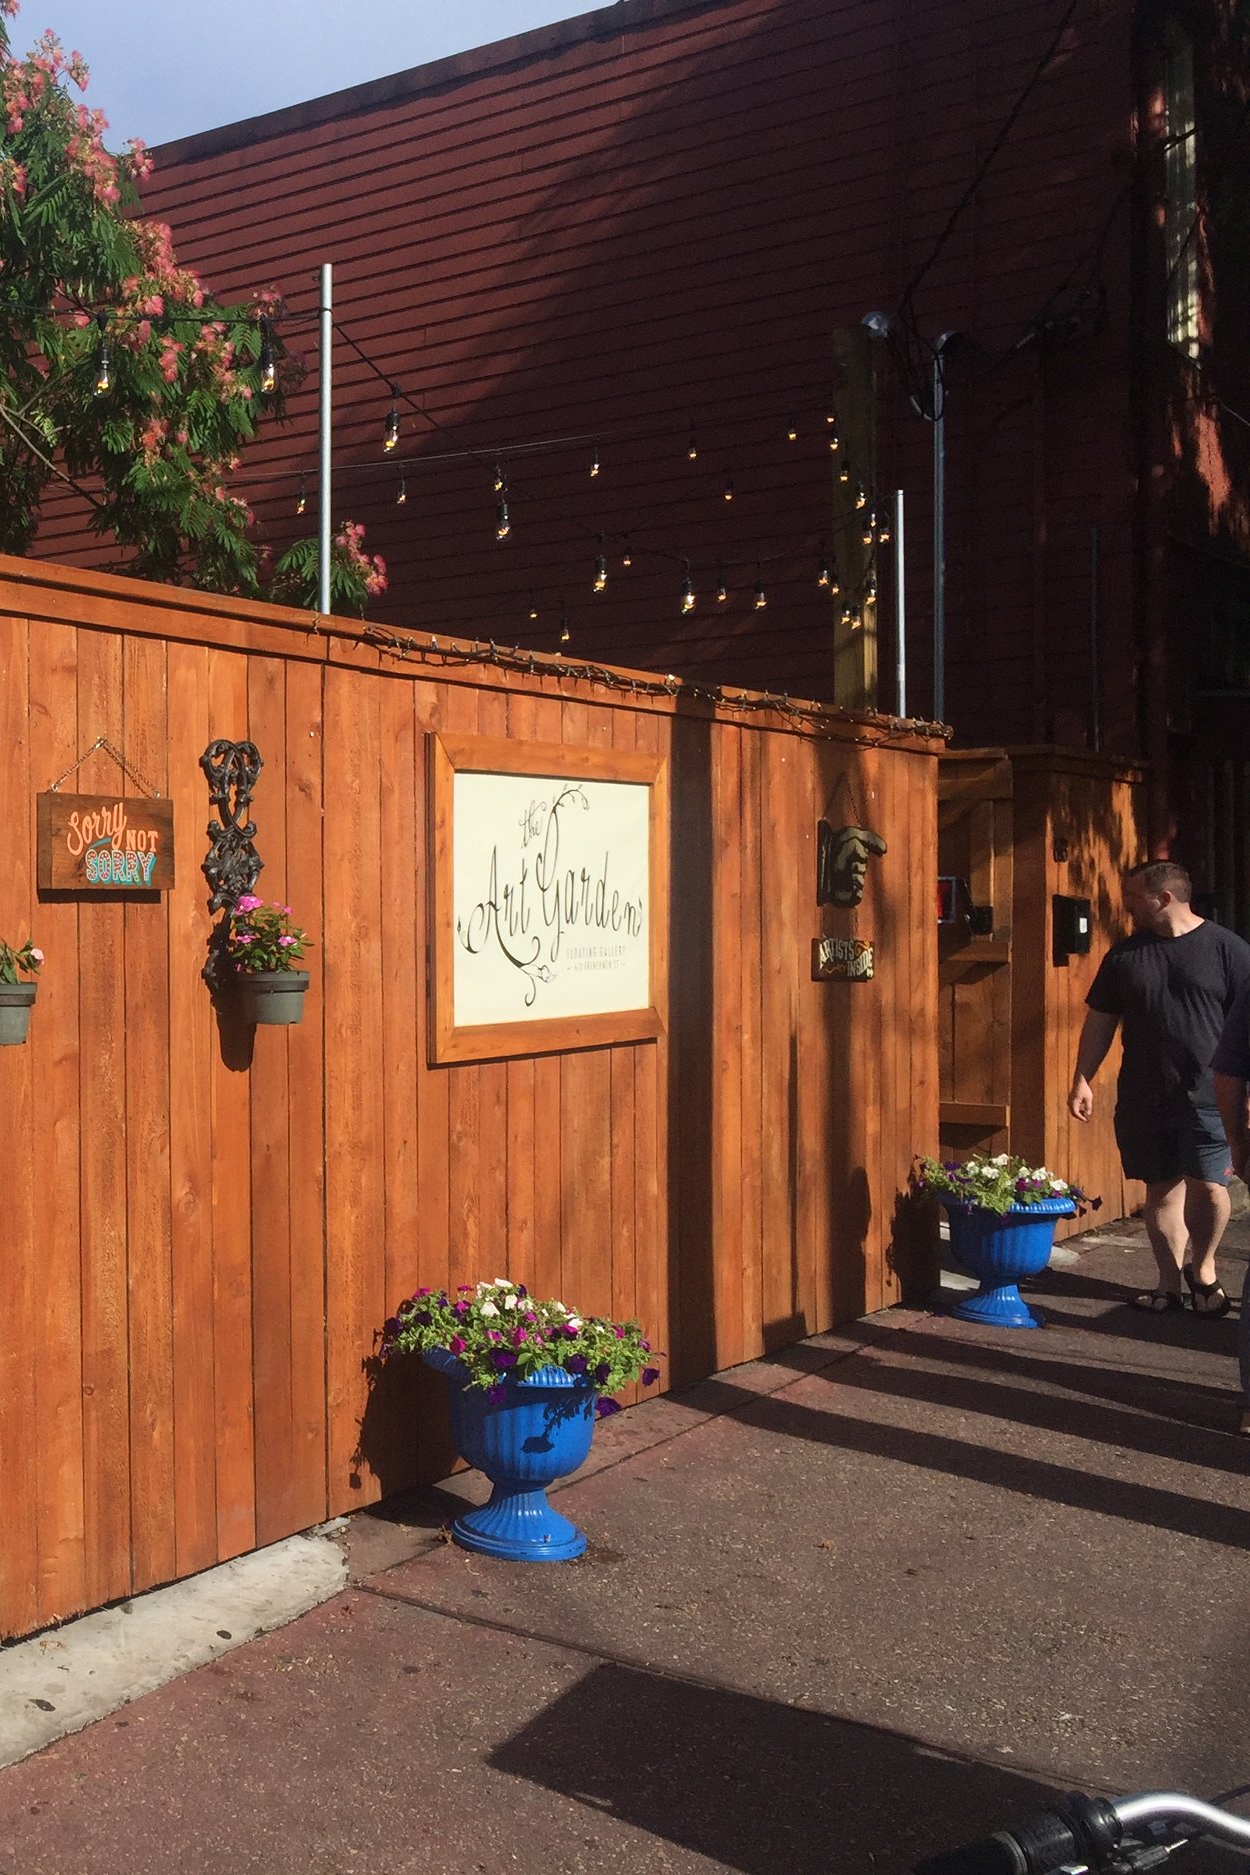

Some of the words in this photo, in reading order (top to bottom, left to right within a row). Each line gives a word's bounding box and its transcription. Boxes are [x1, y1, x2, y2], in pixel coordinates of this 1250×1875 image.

[67, 802, 127, 856] Sorry
[126, 829, 158, 852] NOT
[85, 849, 157, 886] SORRY
[536, 807, 642, 962] Garden
